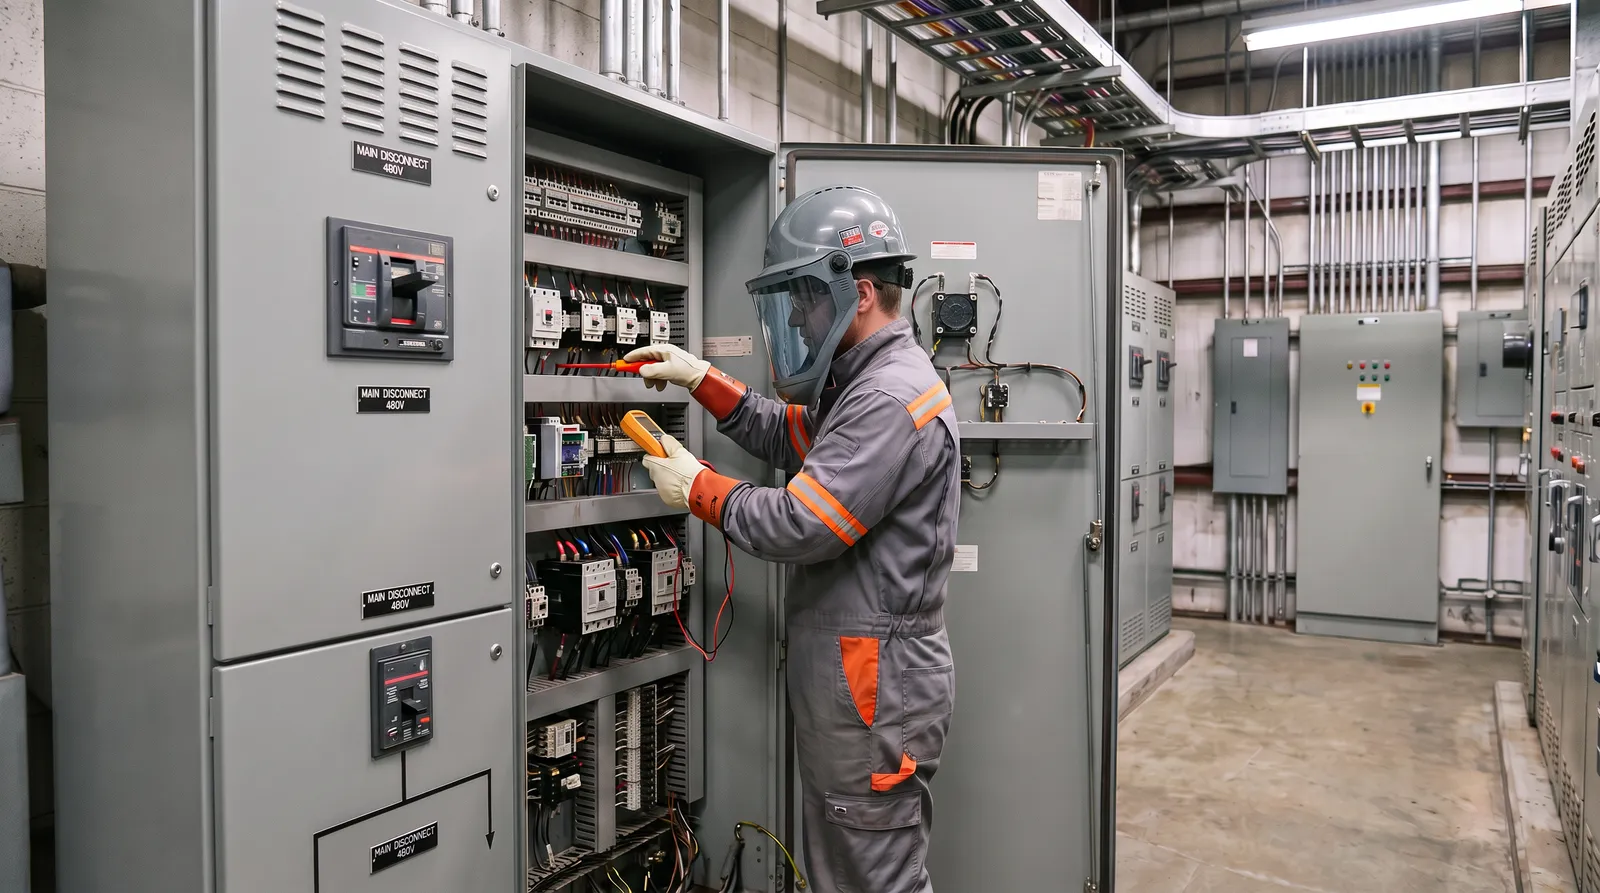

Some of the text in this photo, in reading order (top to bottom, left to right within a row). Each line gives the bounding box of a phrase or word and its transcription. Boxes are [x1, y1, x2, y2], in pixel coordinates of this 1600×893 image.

[356, 144, 429, 170] MAIN DISCONNECT
[382, 162, 404, 176] 480V
[361, 388, 427, 399] MAIN DISCONNECT
[386, 400, 405, 410] 480V
[367, 585, 431, 604] MAIN DISCONNECT
[390, 599, 410, 610] 480V
[374, 826, 435, 858] MAIN DISCONNECT
